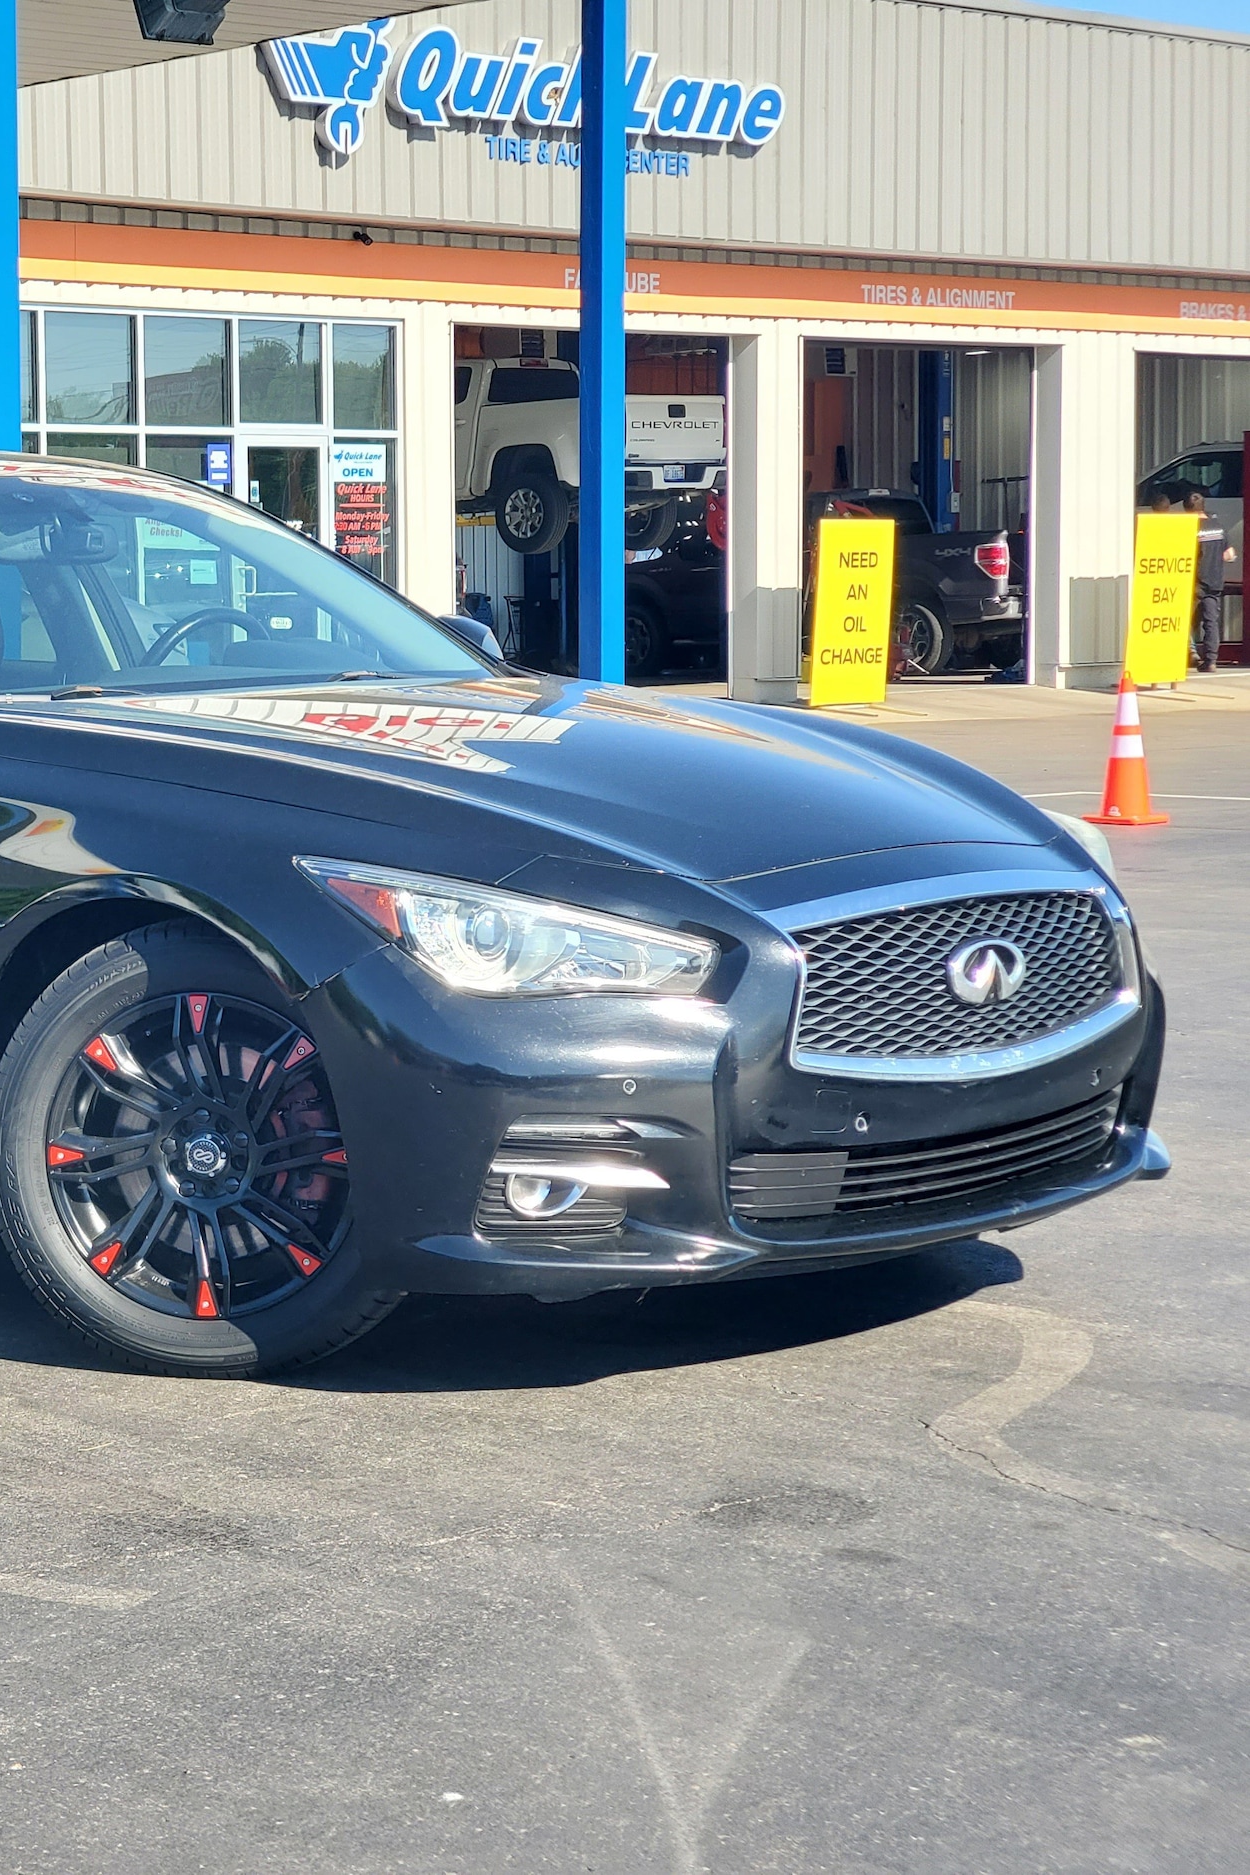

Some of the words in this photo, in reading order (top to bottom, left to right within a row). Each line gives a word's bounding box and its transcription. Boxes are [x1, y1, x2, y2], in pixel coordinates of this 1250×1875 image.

[626, 52, 786, 146] Lane
[485, 136, 532, 164] TIRE
[537, 140, 551, 165] &
[626, 150, 690, 176] ENTER
[626, 272, 661, 294] UBE
[861, 284, 907, 305] TIRES
[911, 287, 922, 306] &
[926, 288, 1015, 309] ALIGNMENT
[1180, 302, 1234, 319] BRAKES
[1237, 305, 1247, 321] &
[631, 421, 719, 429] CHEVROLET
[344, 452, 363, 460] Quick
[365, 452, 383, 460] Lane
[342, 468, 373, 477] OPEN
[337, 483, 363, 495] Quick
[365, 484, 387, 494] Lane
[350, 494, 374, 502] HOURS
[348, 522, 361, 531] AM
[345, 535, 379, 545] Saturday
[840, 552, 878, 568] NEED
[1139, 557, 1192, 574] SERVICE
[846, 584, 868, 600] AN
[1152, 587, 1177, 603] BAY
[843, 616, 867, 632] OIL
[1141, 617, 1181, 633] OPEN!
[820, 648, 883, 664] CHANGE
